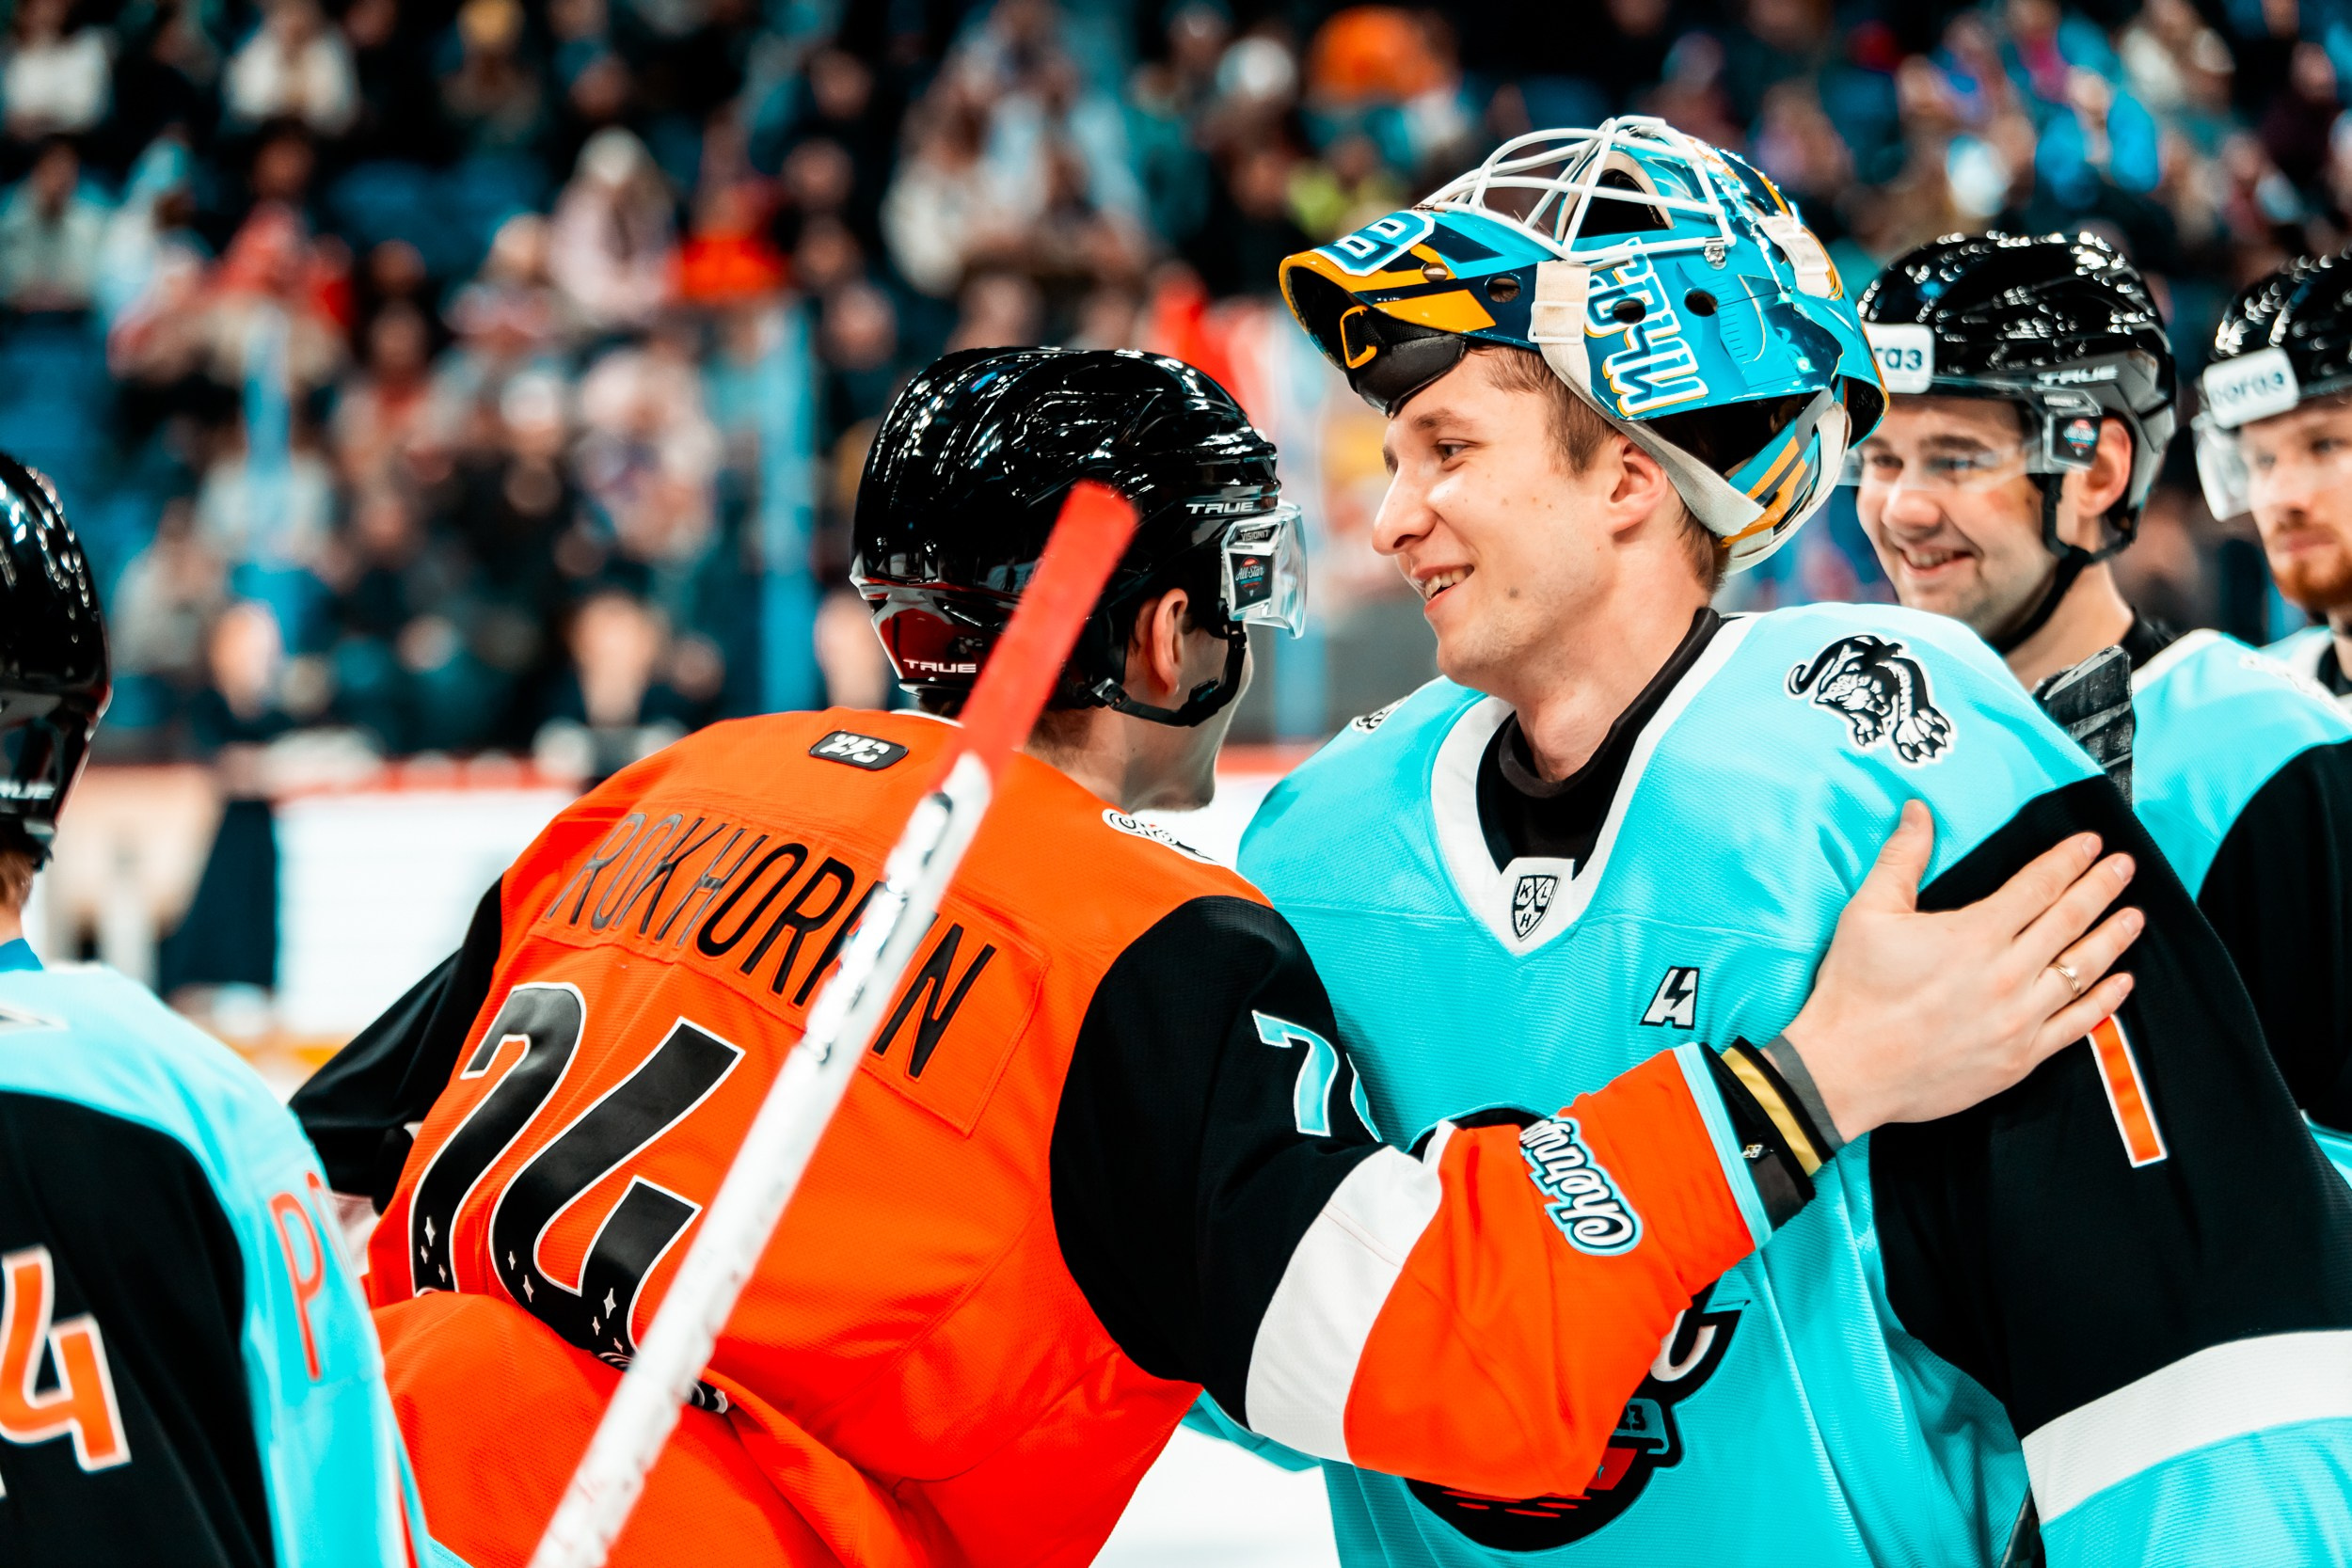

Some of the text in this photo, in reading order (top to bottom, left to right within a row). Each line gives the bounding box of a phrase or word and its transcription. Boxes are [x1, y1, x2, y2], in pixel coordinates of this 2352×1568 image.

[2037, 365, 2118, 386] TRUE
[1185, 501, 1254, 515] TRUE
[903, 658, 977, 673] TRUE
[1251, 1009, 1383, 1142] 7
